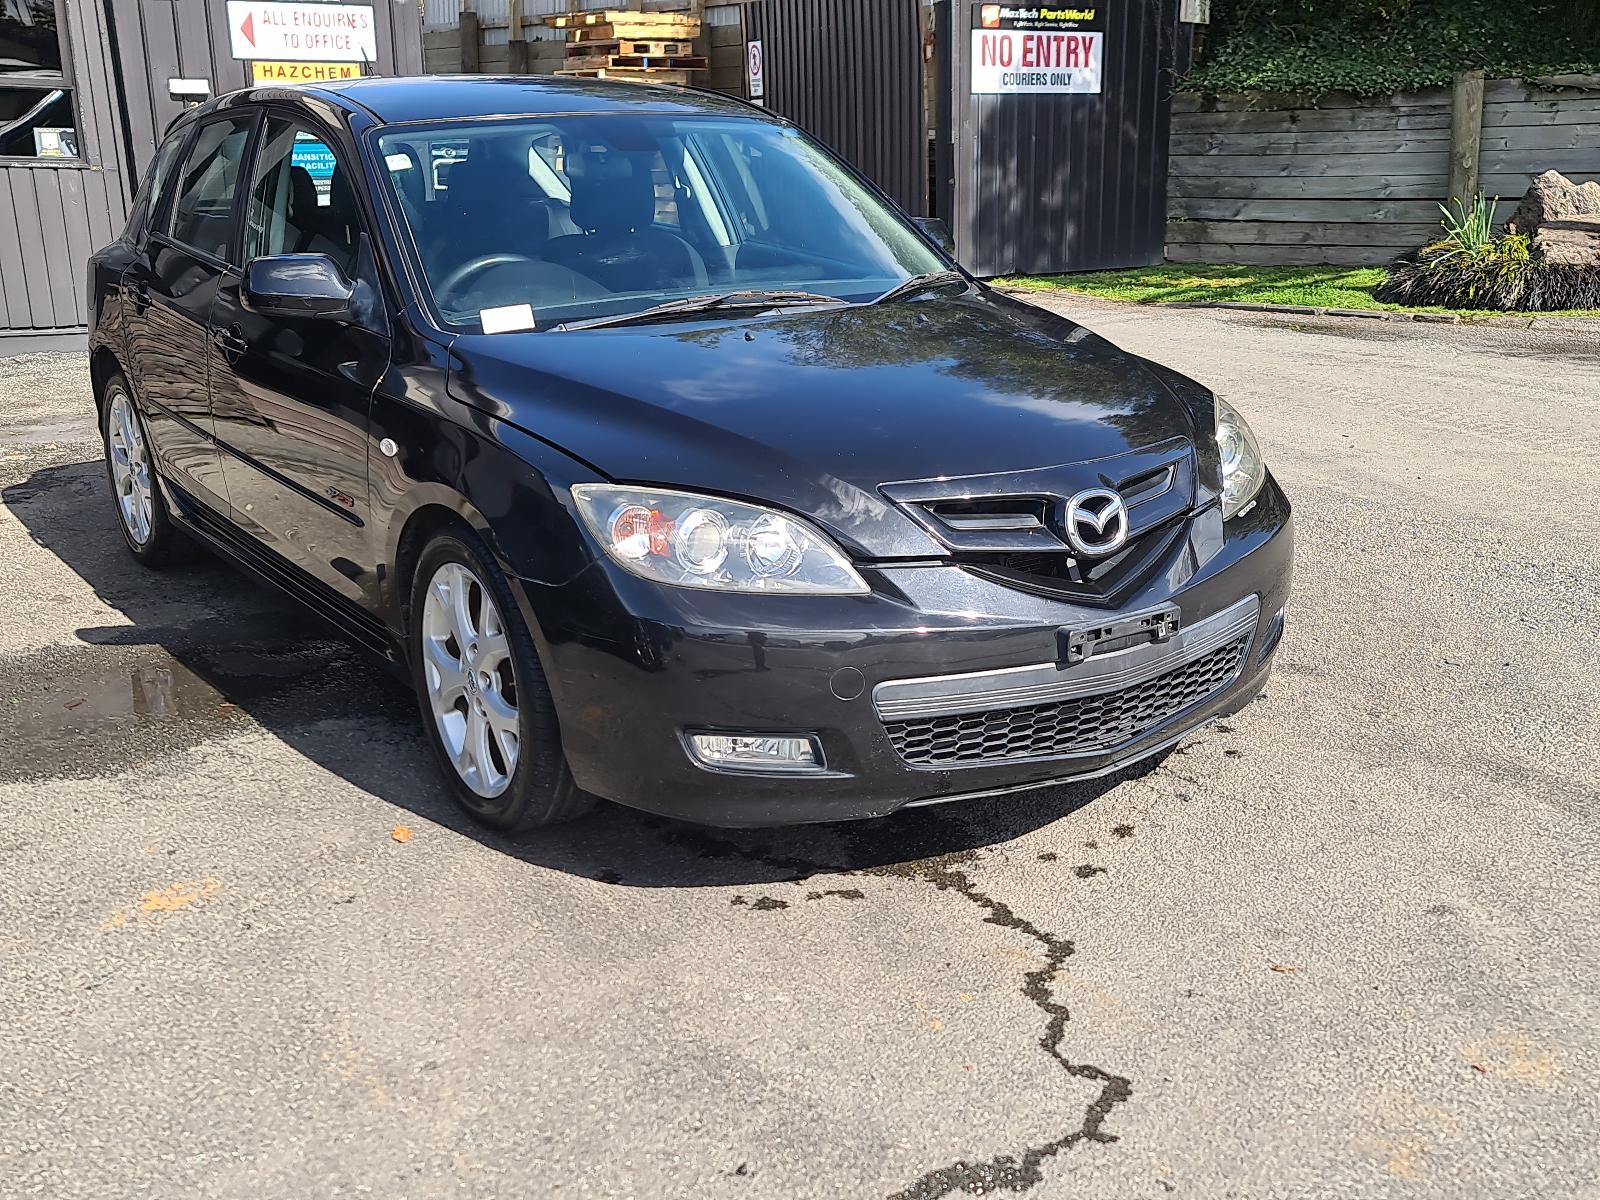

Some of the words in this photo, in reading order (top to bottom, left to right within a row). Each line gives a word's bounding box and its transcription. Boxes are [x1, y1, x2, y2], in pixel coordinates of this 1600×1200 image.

[263, 10, 287, 25] ALL
[293, 11, 368, 29] ENQUIRIES
[1000, 8, 1039, 19] MazTech
[1040, 8, 1096, 20] PartsWorld
[283, 33, 300, 49] TO
[305, 34, 352, 49] OFFICE
[981, 34, 1013, 67] NO
[1022, 34, 1095, 68] ENTRY
[262, 65, 352, 80] HAZCHEM
[1002, 72, 1048, 86] COURIERS
[1050, 72, 1073, 86] ONLY
